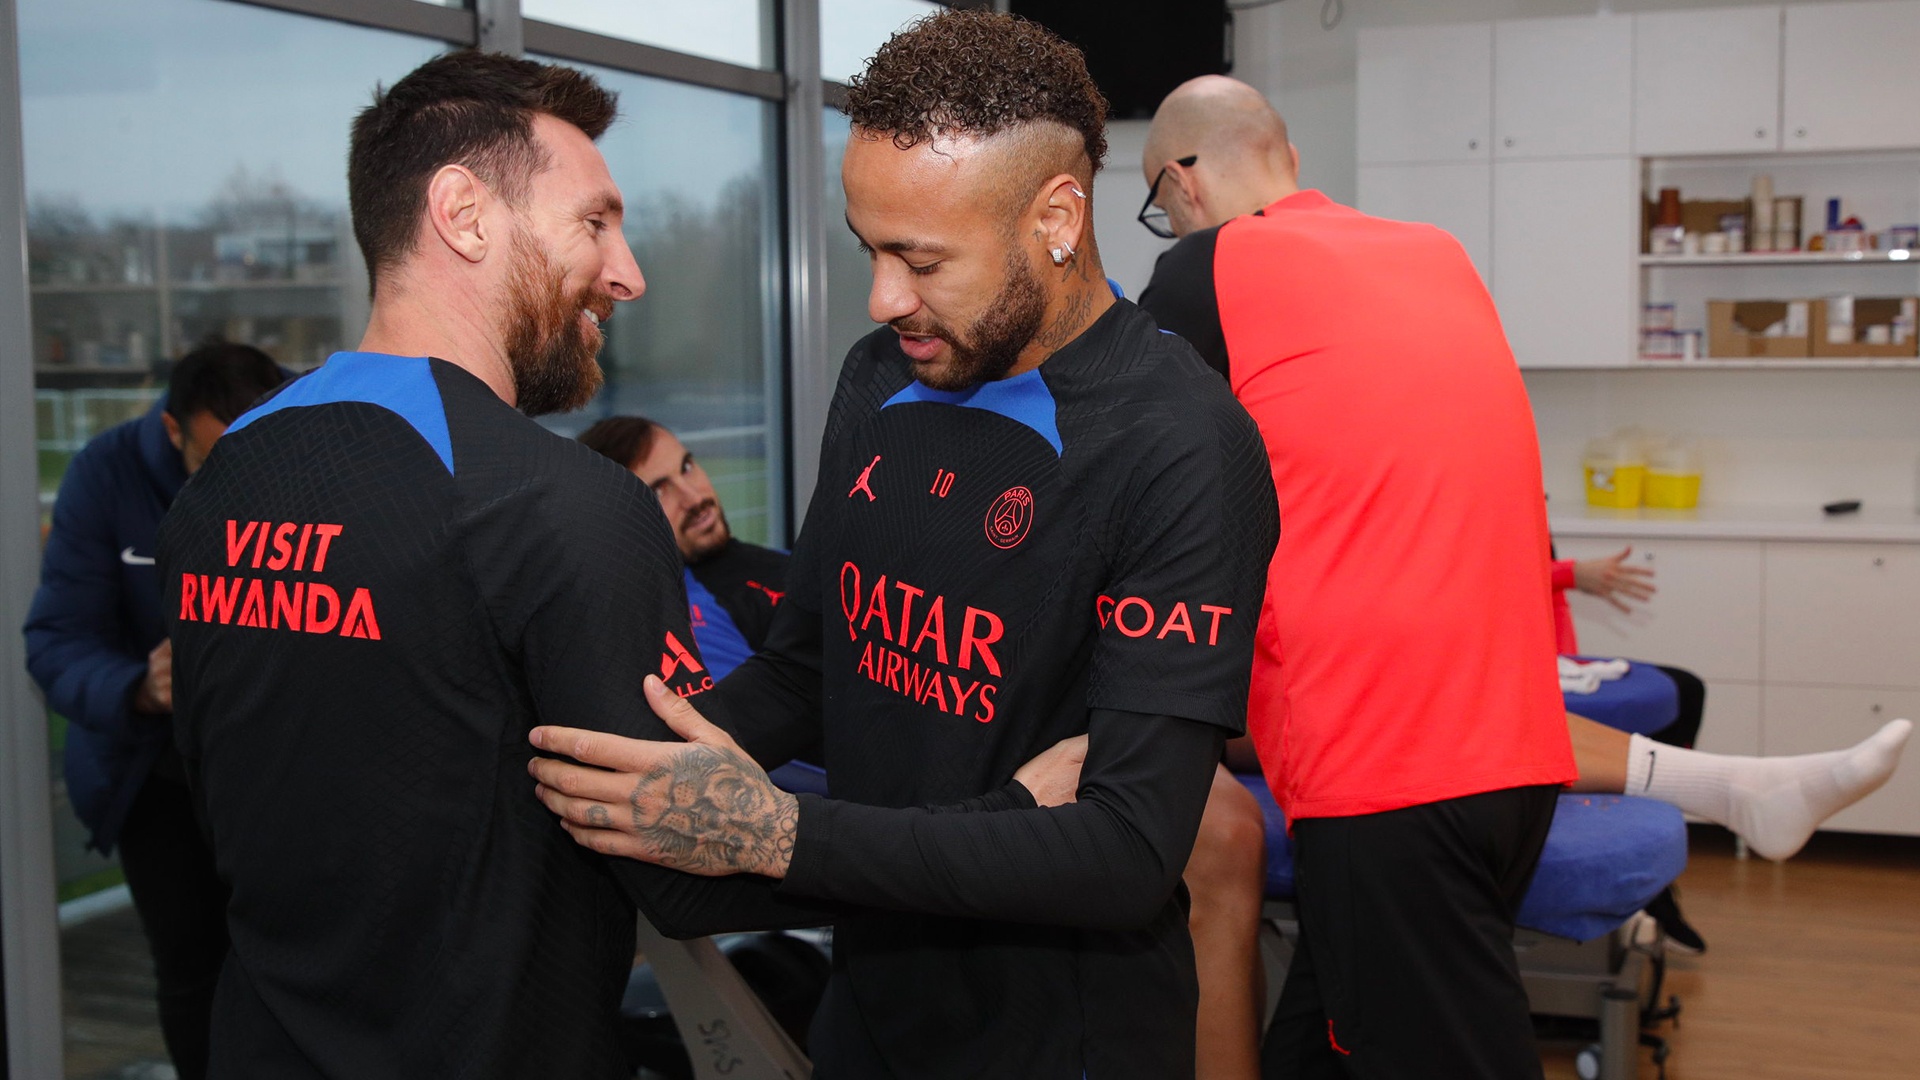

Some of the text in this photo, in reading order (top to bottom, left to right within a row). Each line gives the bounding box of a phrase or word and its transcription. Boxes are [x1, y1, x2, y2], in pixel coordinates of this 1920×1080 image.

[929, 468, 956, 498] 10
[1004, 489, 1030, 507] PARIS
[226, 519, 344, 572] VISIT
[179, 571, 382, 641] RWANDA
[840, 561, 1005, 678] QATAR
[1096, 594, 1233, 646] GOAT
[676, 676, 715, 698] LL.C
[857, 640, 998, 724] AIRWAYS
